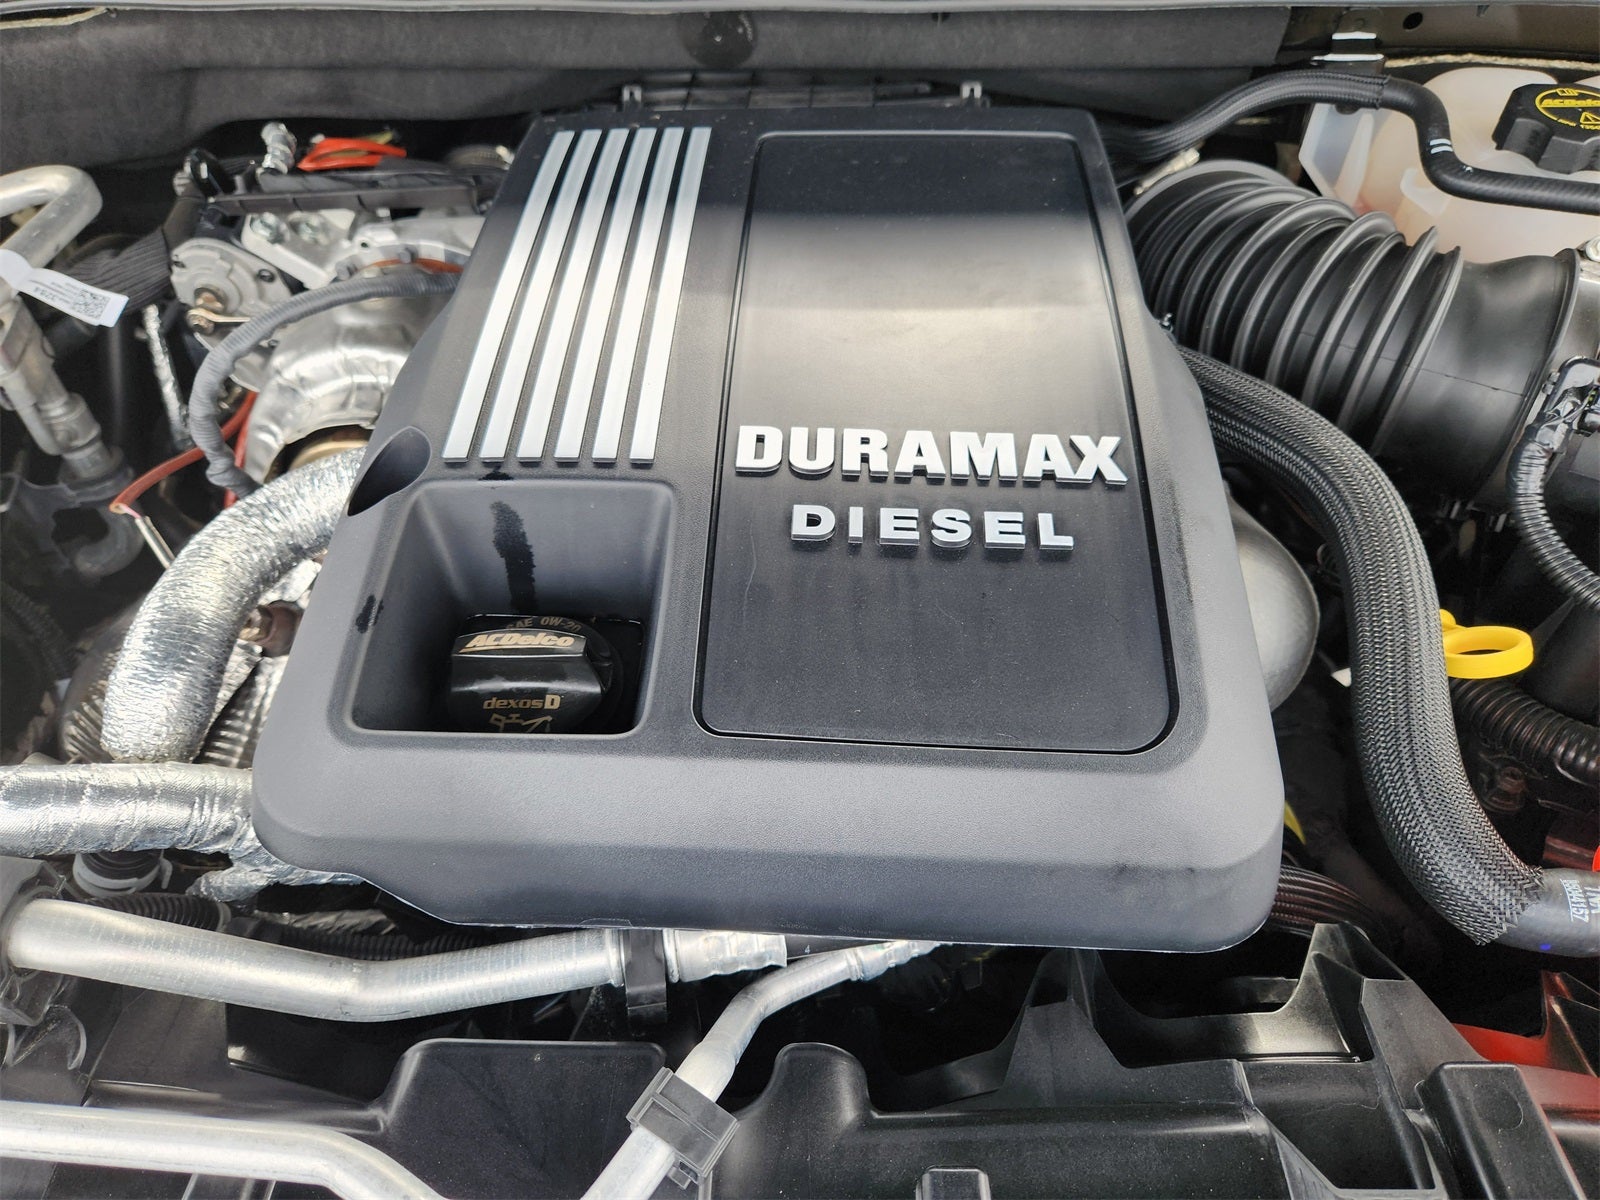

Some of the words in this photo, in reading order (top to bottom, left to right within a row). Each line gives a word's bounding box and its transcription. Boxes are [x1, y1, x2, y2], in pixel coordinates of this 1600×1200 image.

[736, 425, 1128, 485] DURAMAX
[791, 505, 1074, 550] DIESEL
[541, 616, 582, 632] 0W-20
[465, 632, 575, 649] ACDelco
